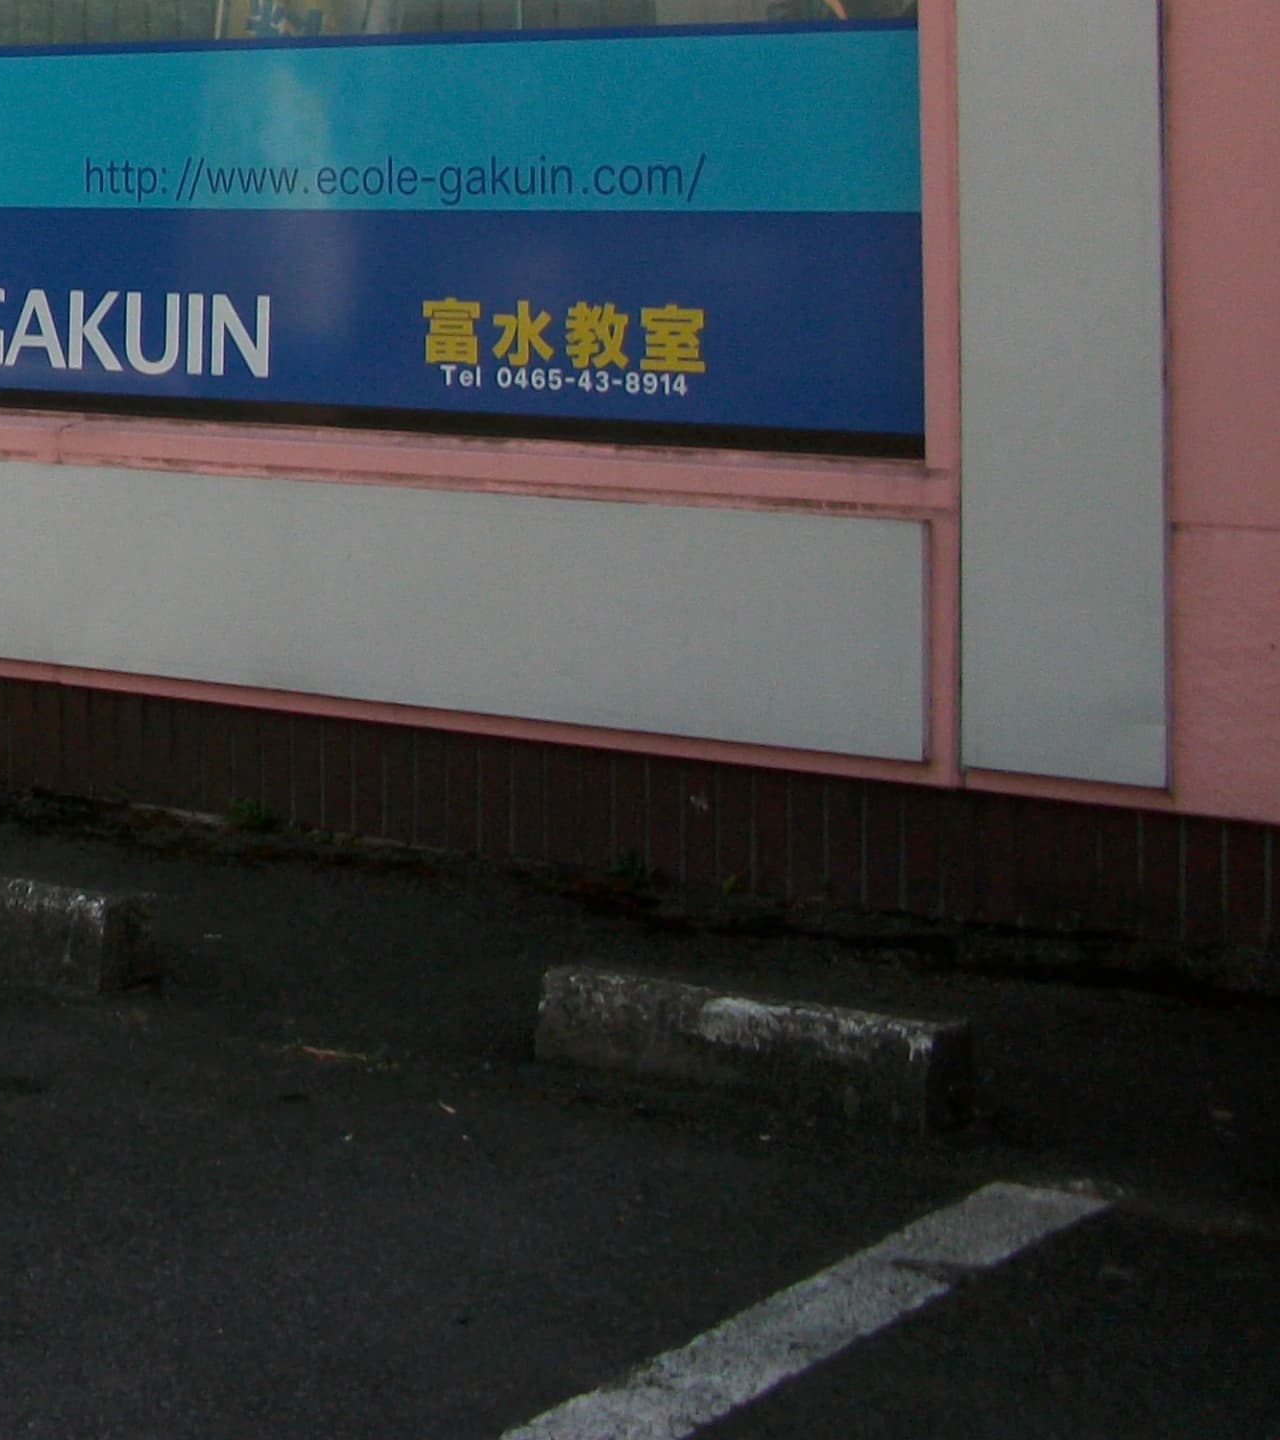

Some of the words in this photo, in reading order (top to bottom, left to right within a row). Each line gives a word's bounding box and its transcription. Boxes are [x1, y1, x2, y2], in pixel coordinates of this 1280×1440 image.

[85, 152, 708, 206] http://www.ecole-gakuin.com/
[421, 296, 707, 375] 富水教室
[439, 364, 482, 389] Tel
[496, 367, 688, 397] 0465-43-8914
